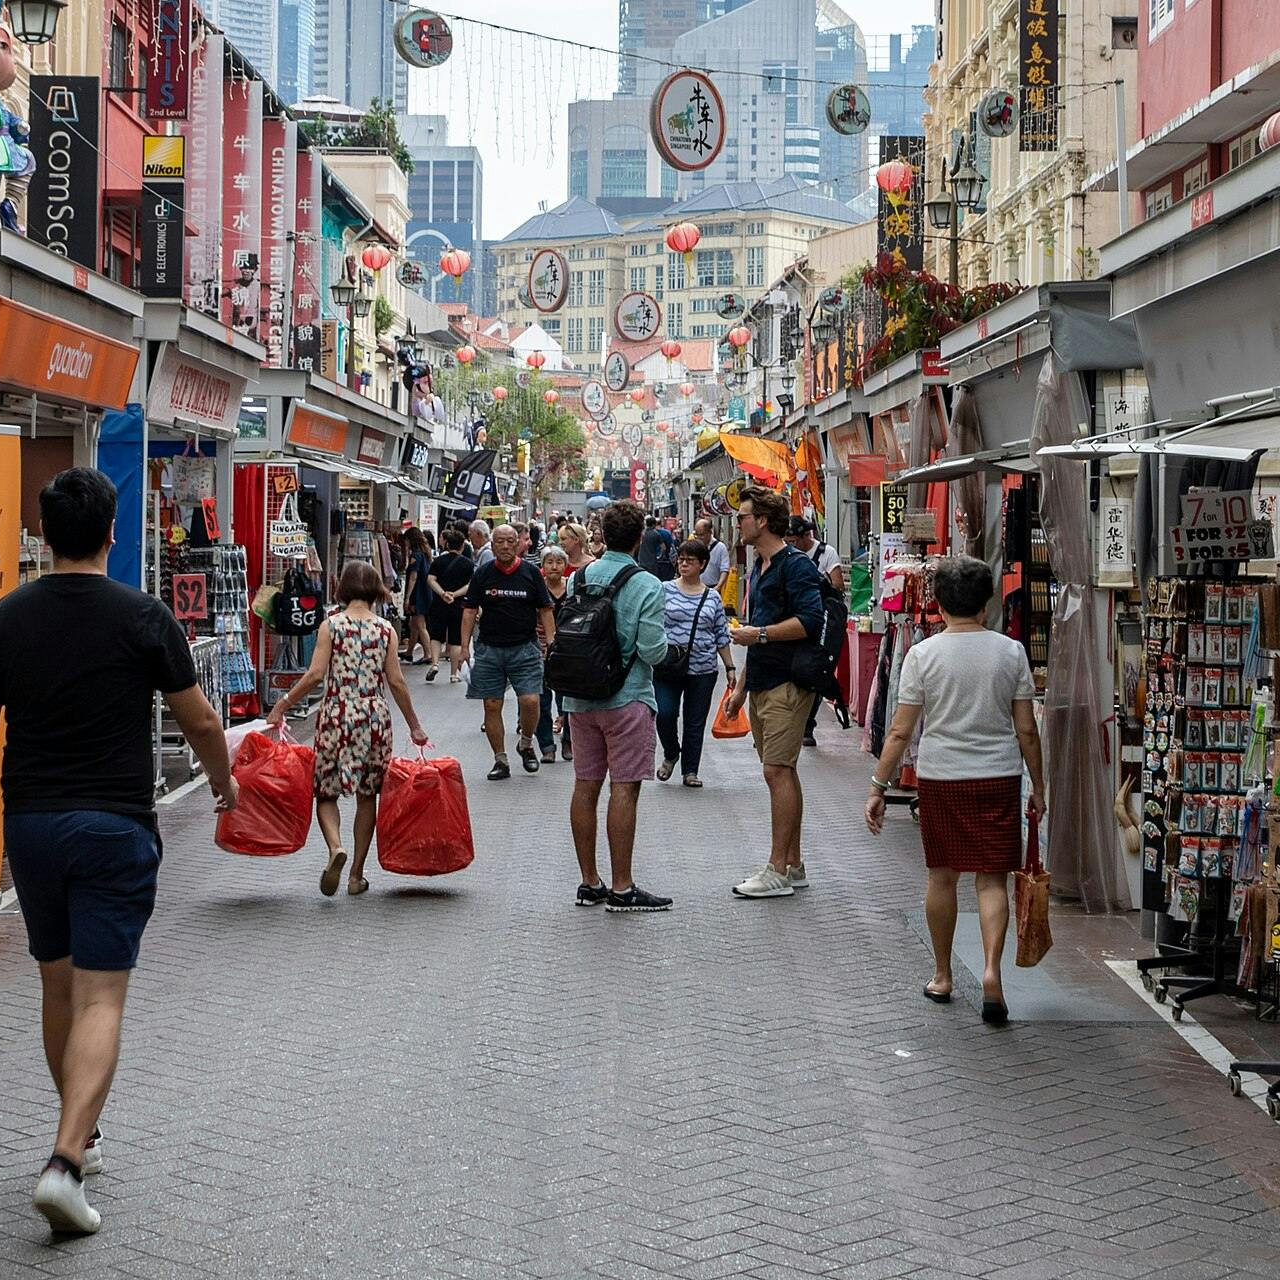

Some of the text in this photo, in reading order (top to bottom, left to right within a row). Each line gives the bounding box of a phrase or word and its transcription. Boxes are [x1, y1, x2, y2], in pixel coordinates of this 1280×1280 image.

[149, 109, 186, 117] 2nd Level
[690, 81, 714, 157] 牛车水
[145, 163, 182, 176] Nikon
[269, 146, 286, 321] CHINATOWN HERITAGE
[156, 222, 167, 285] DG ELECTRONICS
[47, 340, 94, 380] guardian
[888, 497, 905, 510] 50
[1187, 497, 1204, 527] 7
[1171, 527, 1221, 542] 1 FOR
[1174, 547, 1185, 561] 3
[1188, 545, 1224, 561] FOR
[290, 597, 299, 610] I
[291, 611, 317, 626] SG
